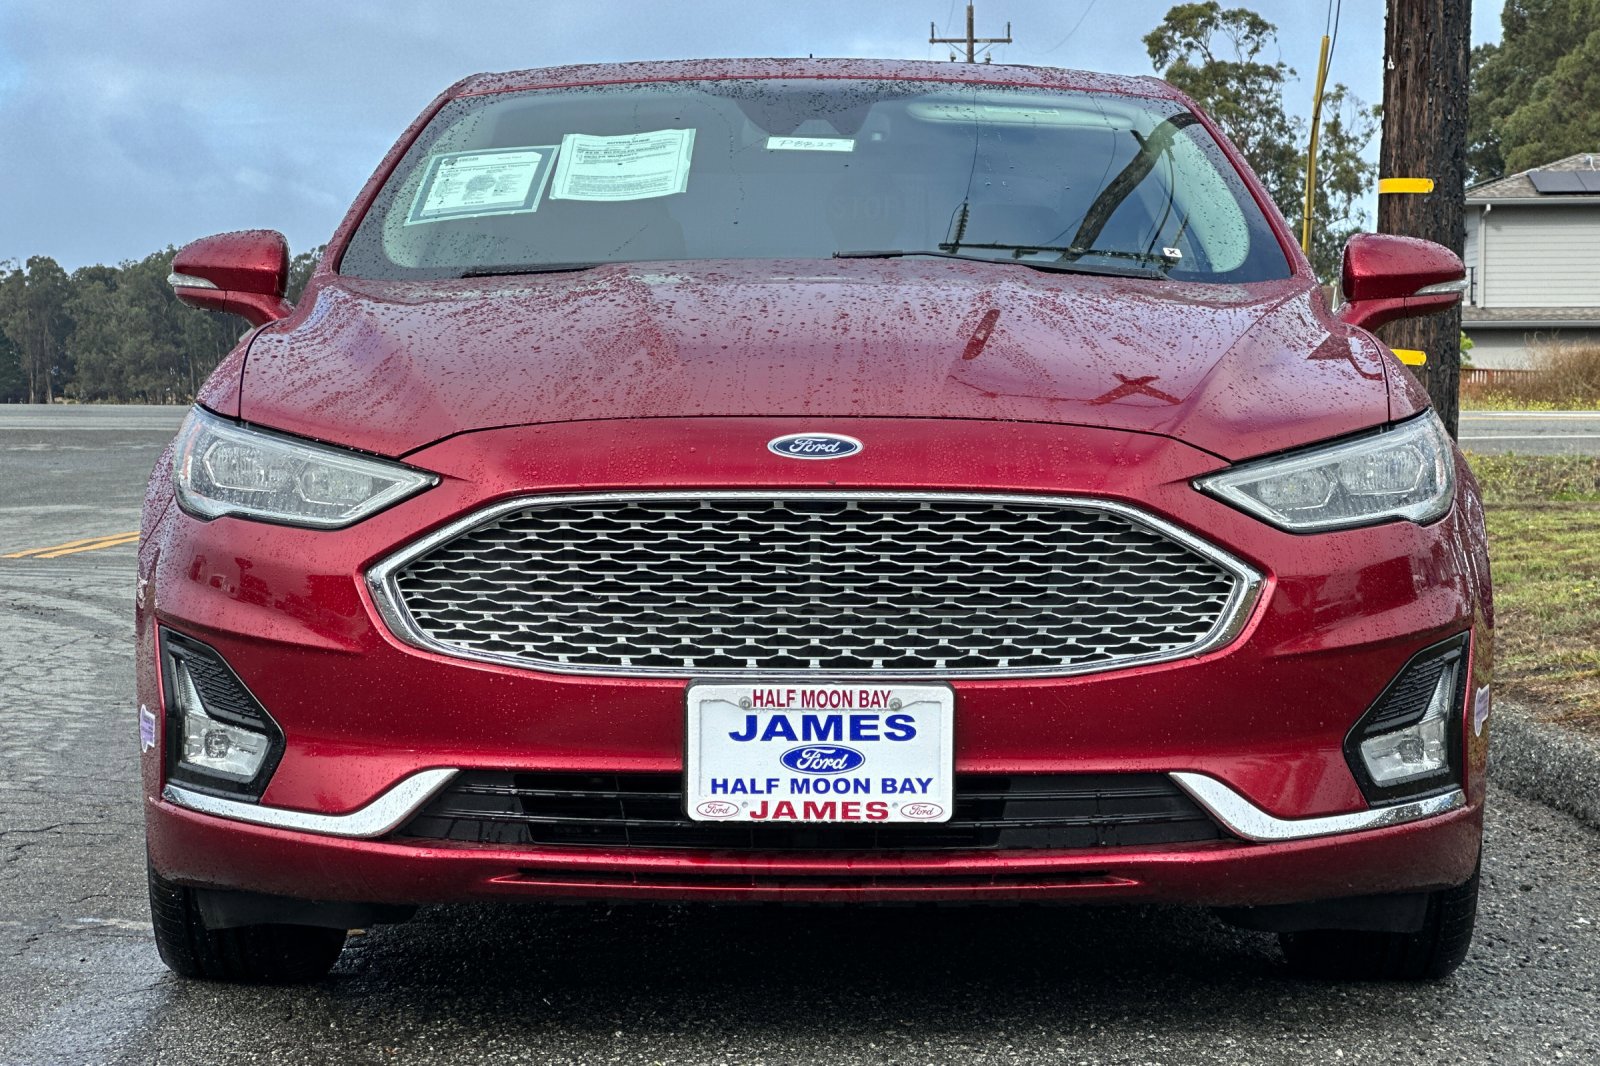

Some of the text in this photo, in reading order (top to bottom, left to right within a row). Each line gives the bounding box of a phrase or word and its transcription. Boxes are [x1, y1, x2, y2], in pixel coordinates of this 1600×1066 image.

[789, 438, 841, 453] Ford
[752, 689, 891, 709] HALF MOON BAY
[728, 714, 917, 742] JAMES
[796, 747, 849, 771] Ford
[711, 778, 934, 795] HALF MOON BAY
[704, 804, 731, 815] Ford
[750, 800, 889, 821] JAMES
[908, 804, 935, 816] Ford
